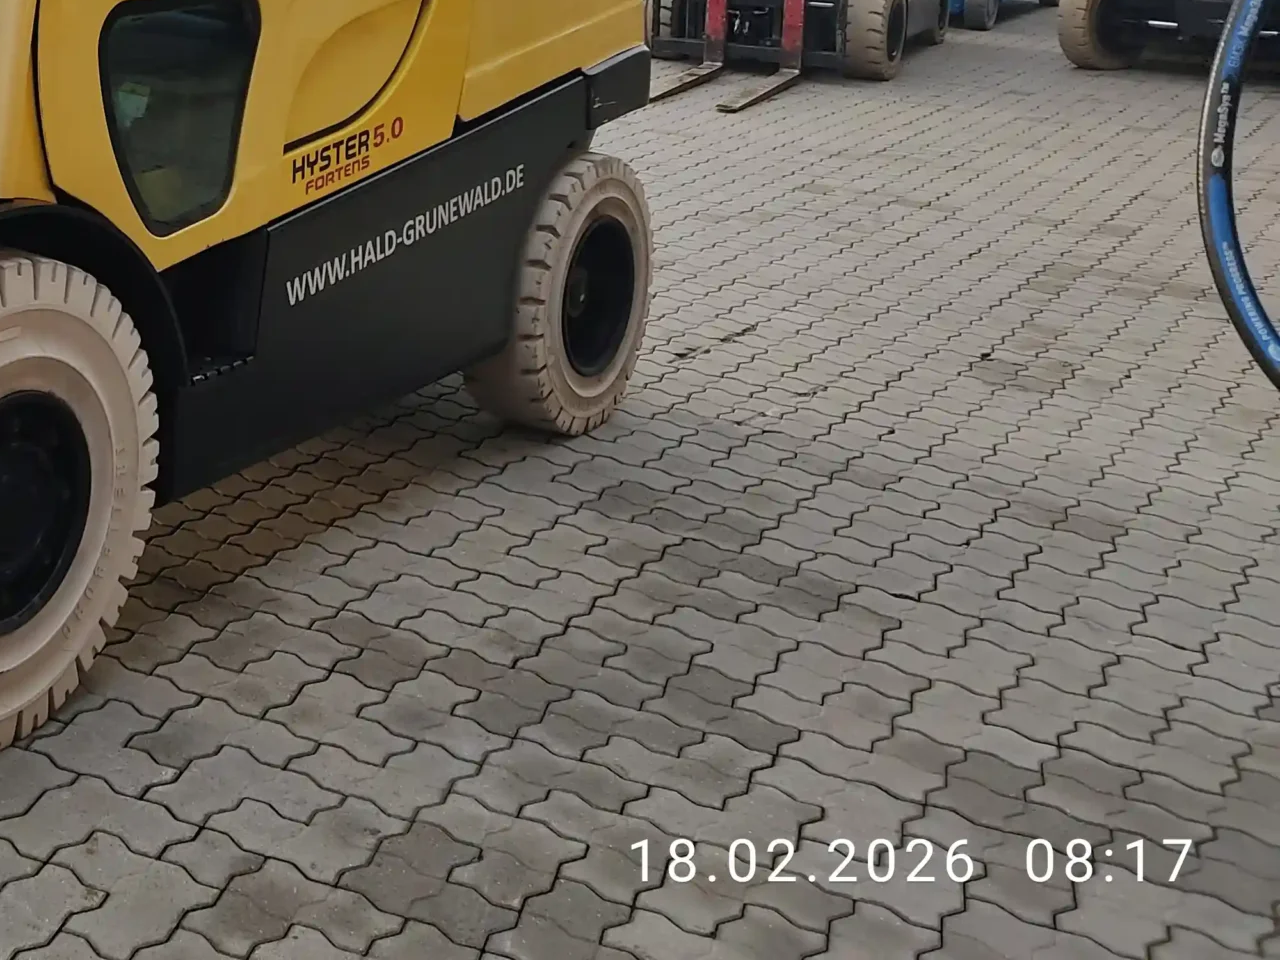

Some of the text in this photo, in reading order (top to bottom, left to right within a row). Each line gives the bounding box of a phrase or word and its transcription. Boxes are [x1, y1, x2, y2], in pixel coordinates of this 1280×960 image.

[292, 116, 404, 184] HYSTER 5.0
[305, 155, 370, 195] FORTENS
[286, 164, 524, 306] WWW.HALD-GRUNEWALD.DE
